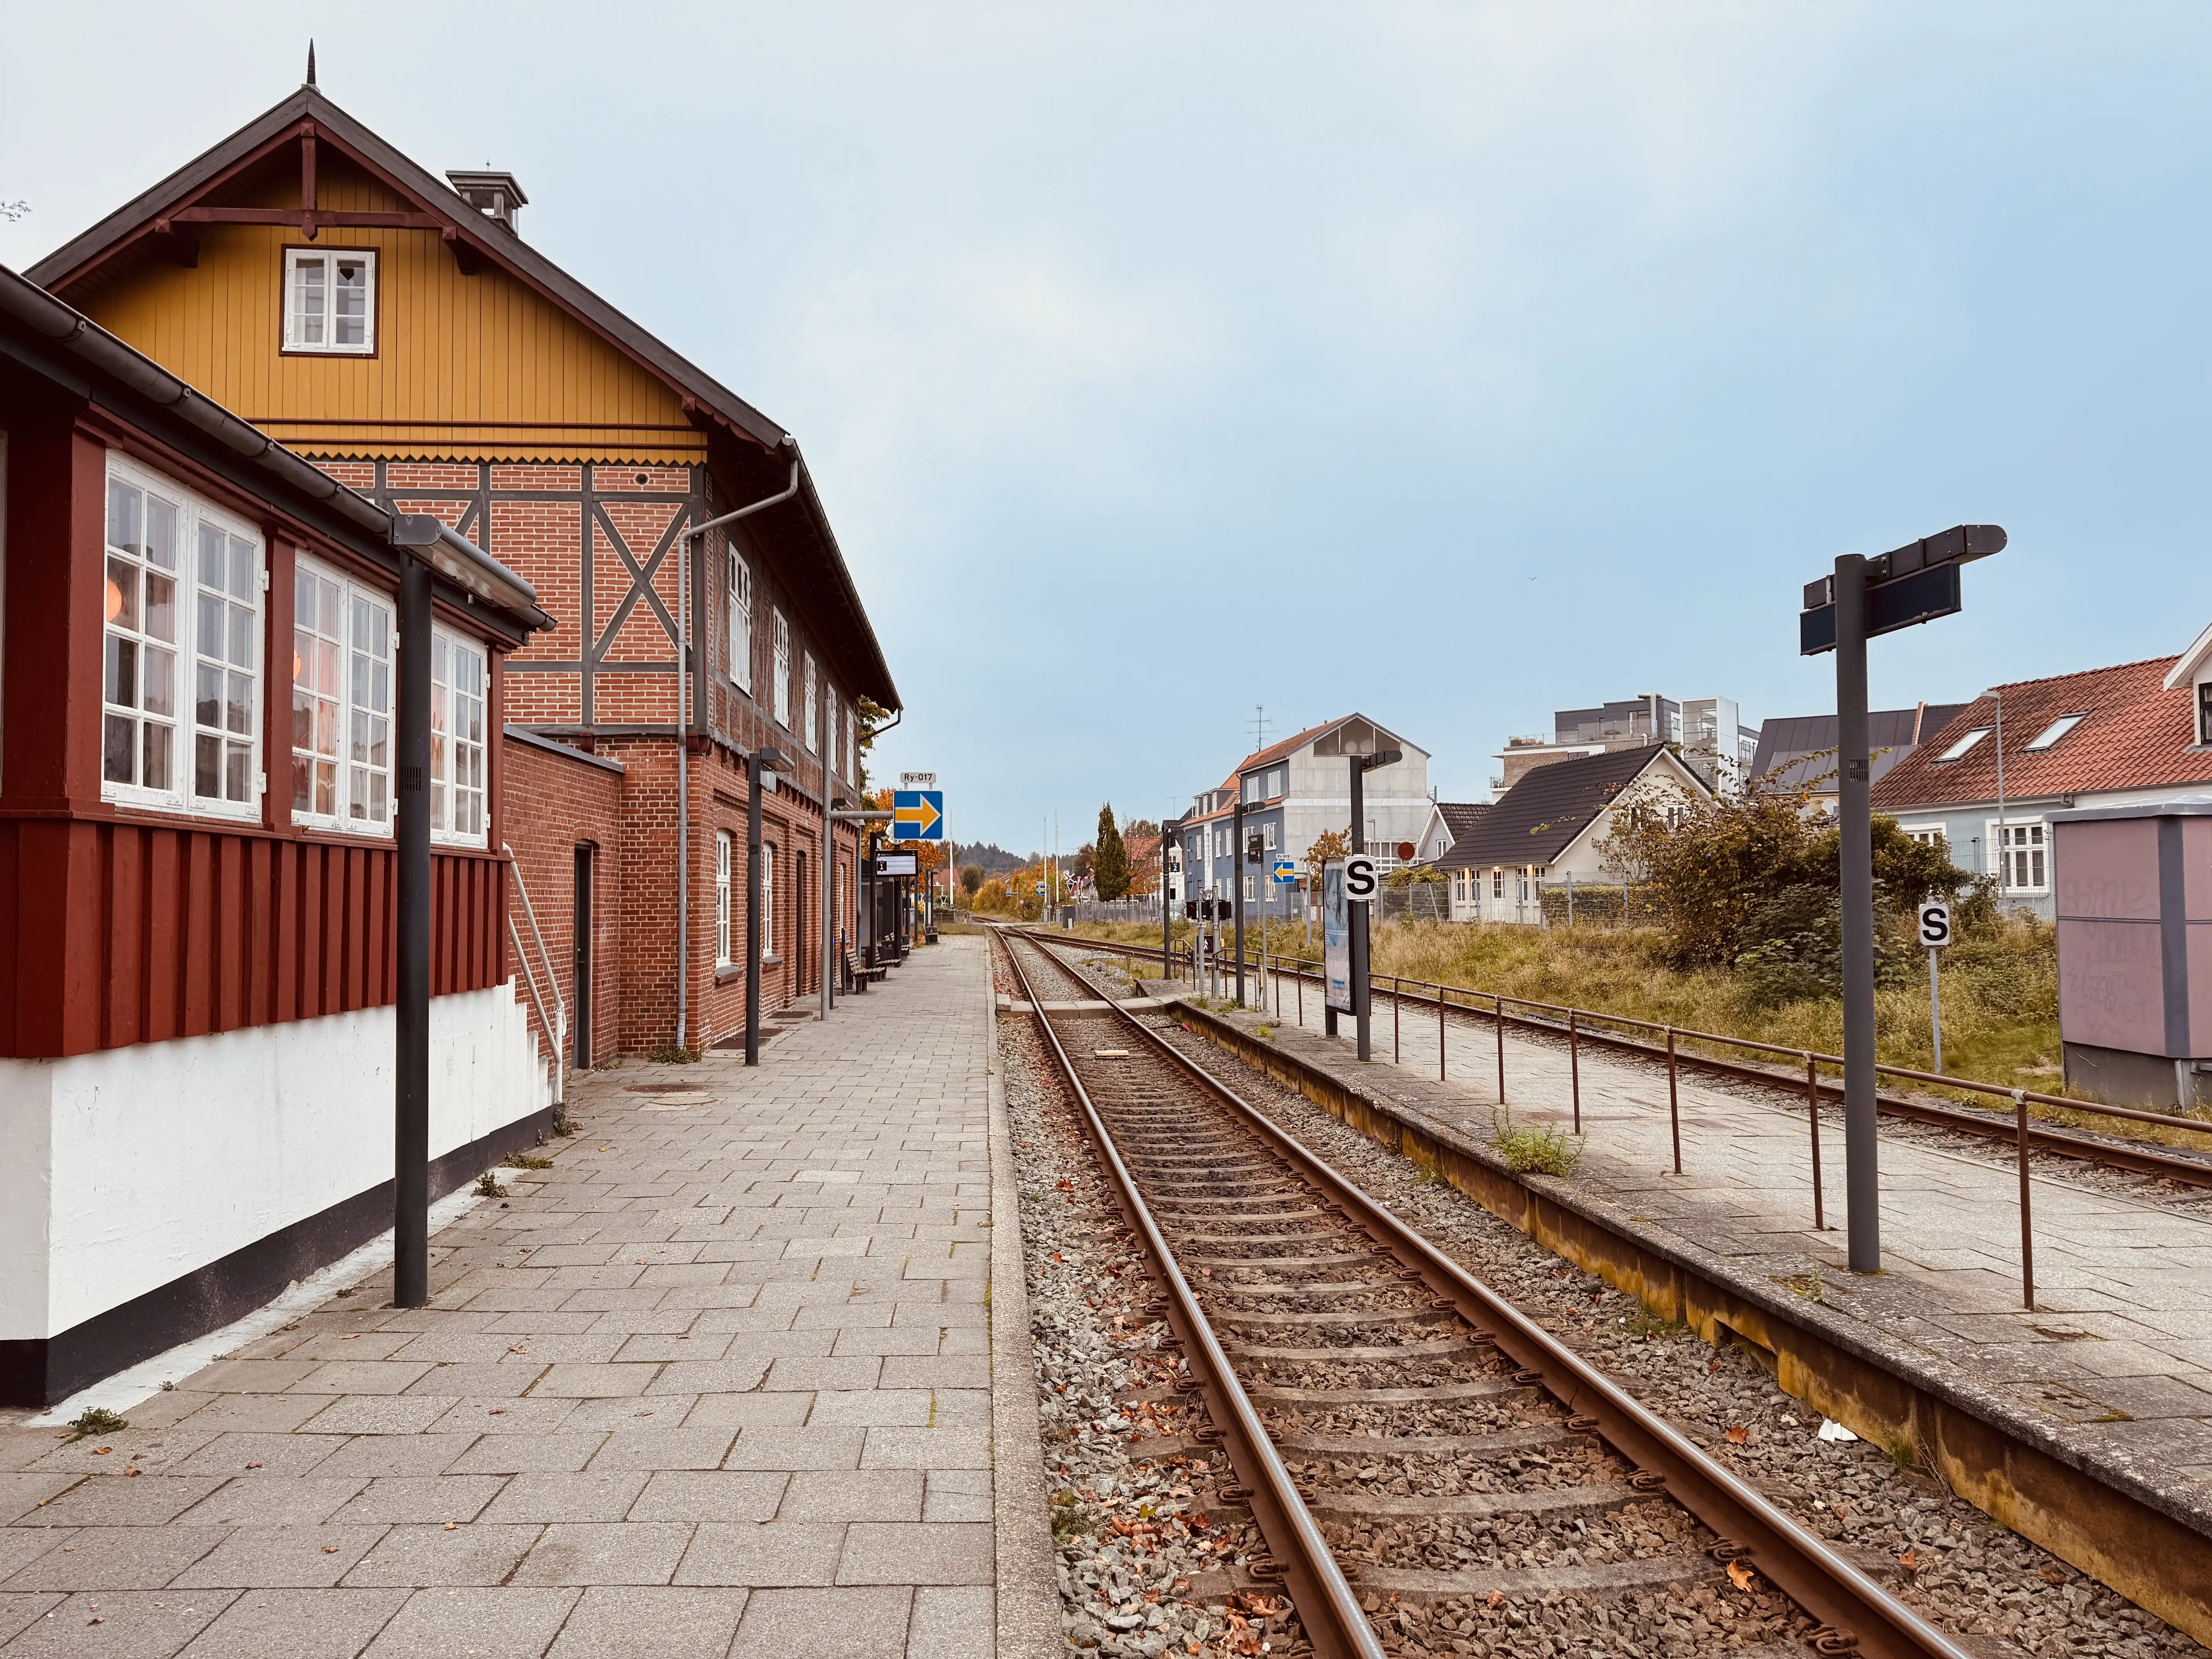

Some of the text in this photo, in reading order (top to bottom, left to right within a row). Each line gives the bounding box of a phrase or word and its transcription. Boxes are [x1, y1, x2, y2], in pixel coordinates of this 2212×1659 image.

[904, 773, 932, 782] Ry-017
[1347, 860, 1375, 895] S
[1922, 908, 1948, 941] S
